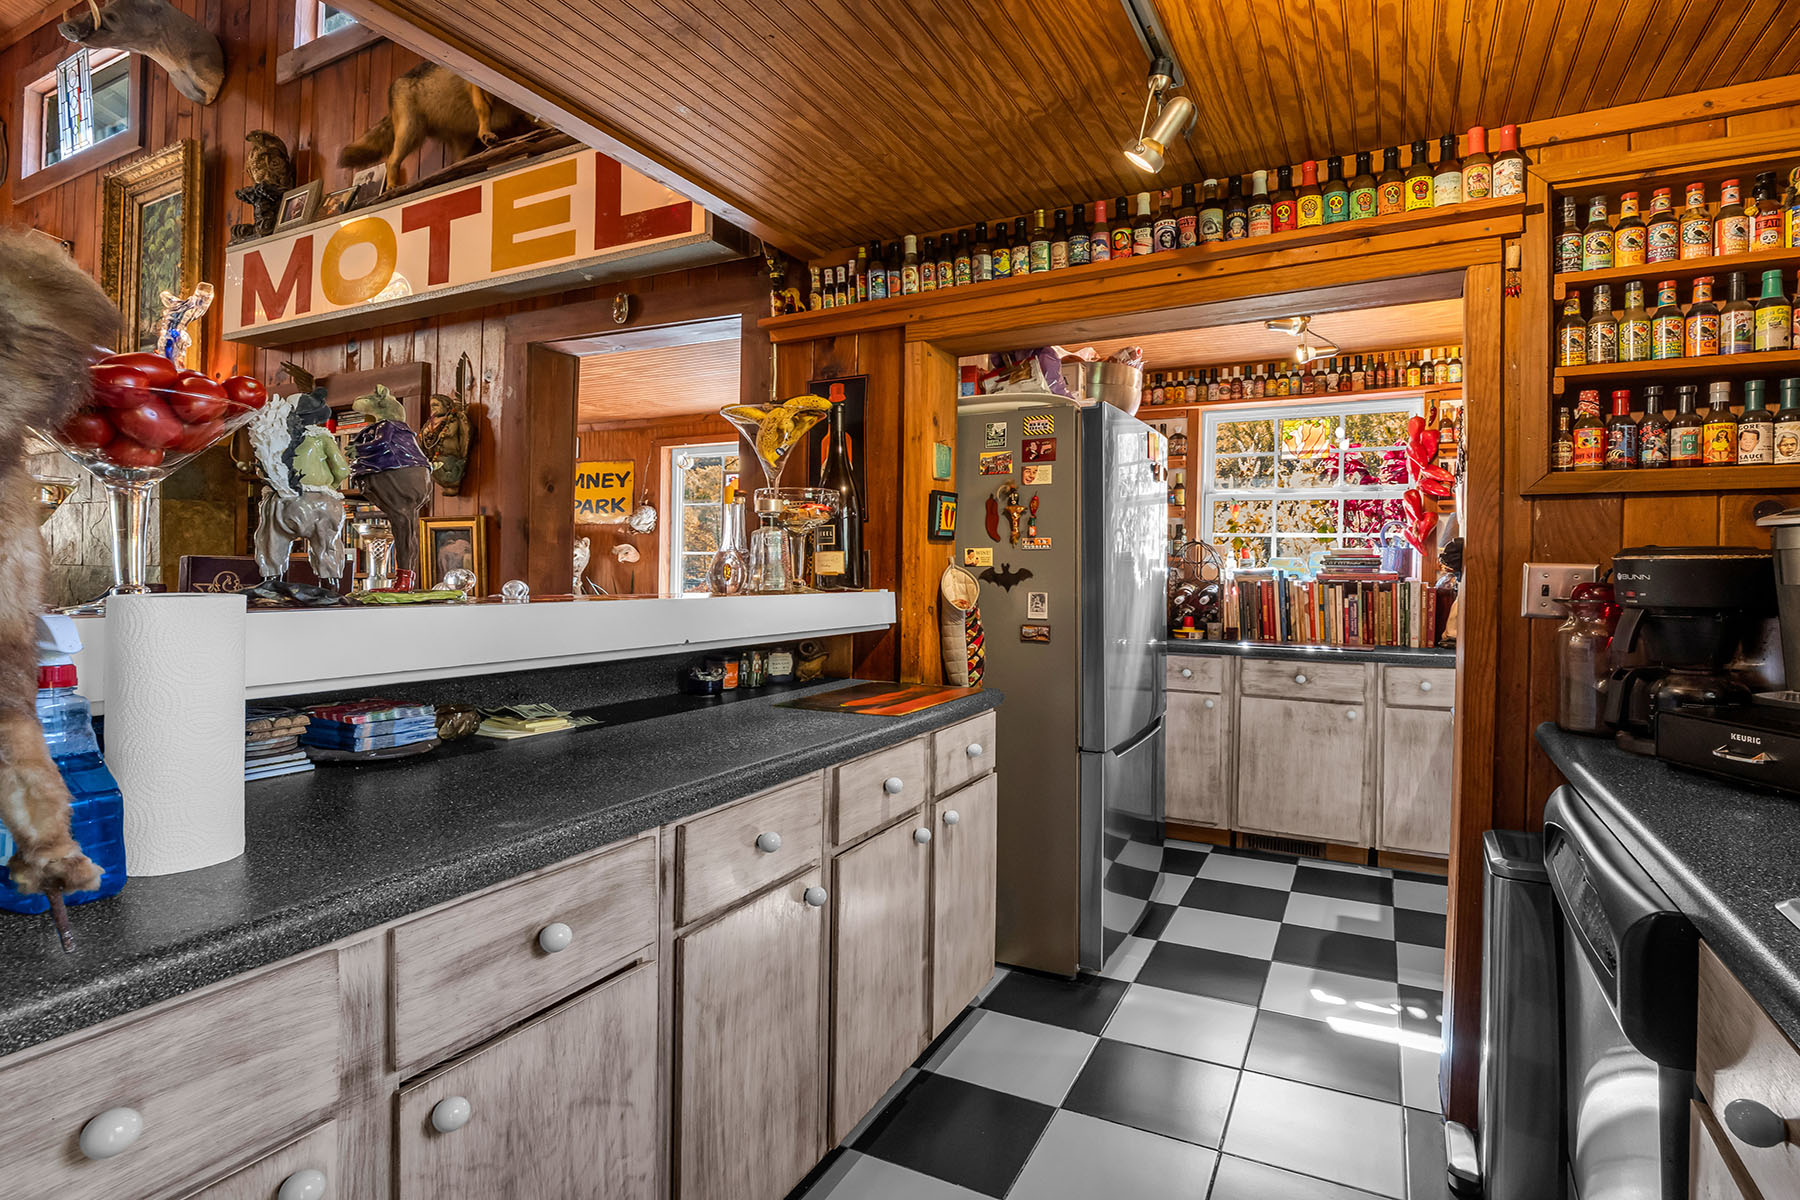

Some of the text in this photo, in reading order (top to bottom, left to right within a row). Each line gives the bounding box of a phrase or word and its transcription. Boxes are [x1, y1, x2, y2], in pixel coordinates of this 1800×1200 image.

[240, 151, 693, 328] MOTEL
[574, 497, 626, 514] PARK
[1622, 573, 1651, 581] BUNN
[1730, 732, 1762, 745] KEURIG
